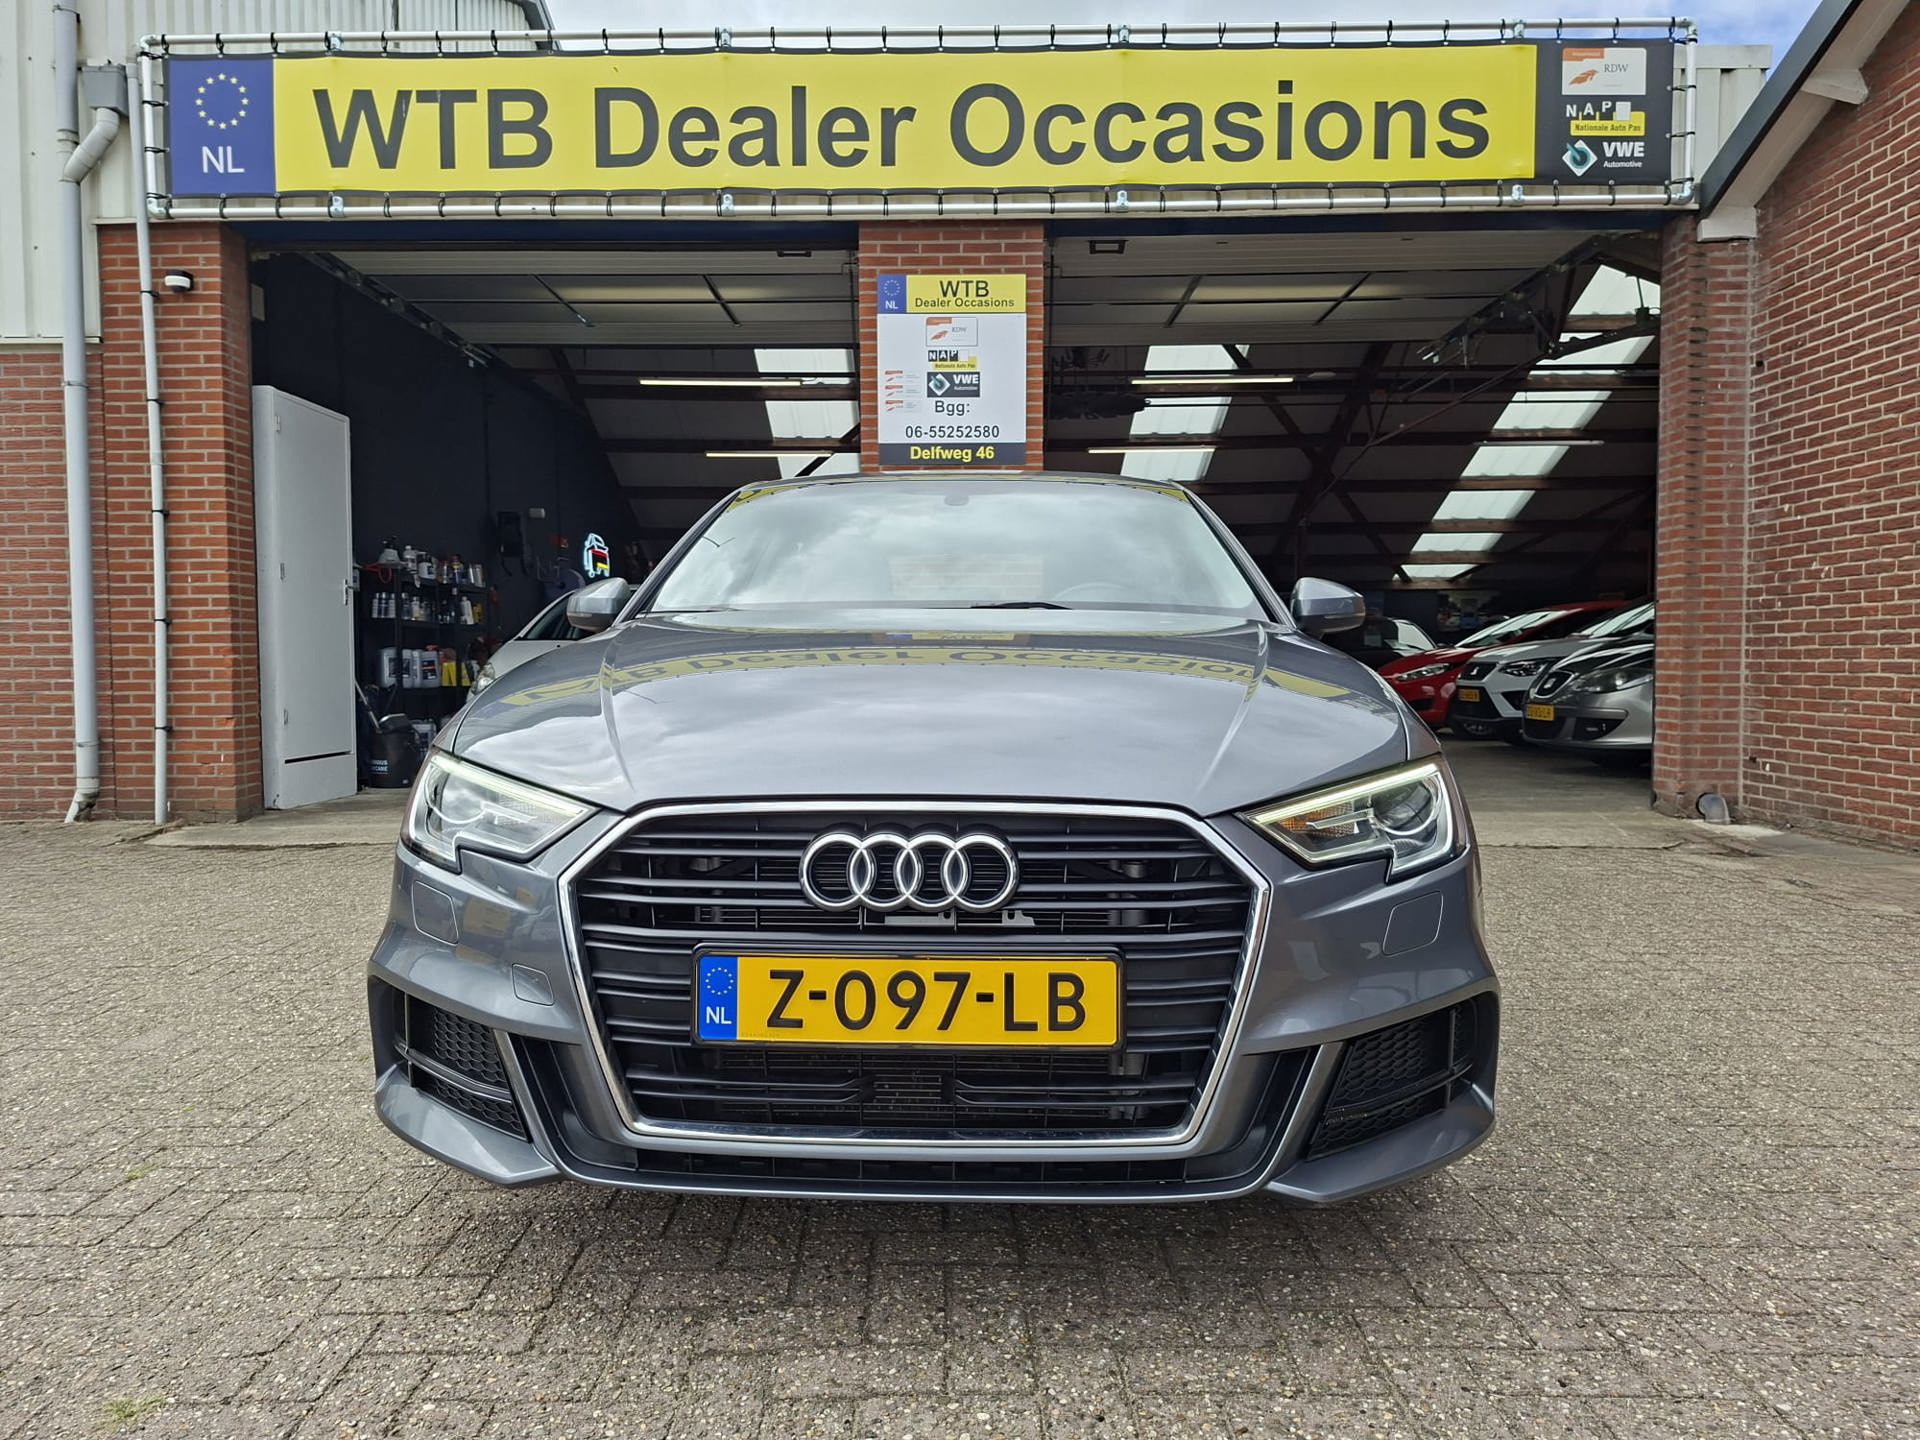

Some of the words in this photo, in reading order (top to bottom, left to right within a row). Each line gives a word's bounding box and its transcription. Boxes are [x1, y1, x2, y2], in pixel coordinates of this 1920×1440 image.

[1604, 63, 1629, 73] RDW
[312, 87, 553, 170] WTB
[594, 86, 917, 168] Dealer
[949, 80, 1490, 168] Occasions
[1602, 142, 1645, 157] VWE
[202, 146, 246, 174] NL
[1603, 160, 1643, 168] Automotive
[940, 280, 989, 297] WTB
[885, 301, 898, 309] NL
[915, 298, 951, 308] Dealer
[955, 298, 1014, 307] Occasions
[953, 374, 979, 384] VWE
[935, 401, 970, 416] Bgg:
[905, 425, 1000, 439] 06-55252580
[910, 446, 972, 462] Delfweg
[976, 446, 994, 460] 46
[766, 970, 1086, 1032] Z-097-LB
[706, 1007, 732, 1025] NL
